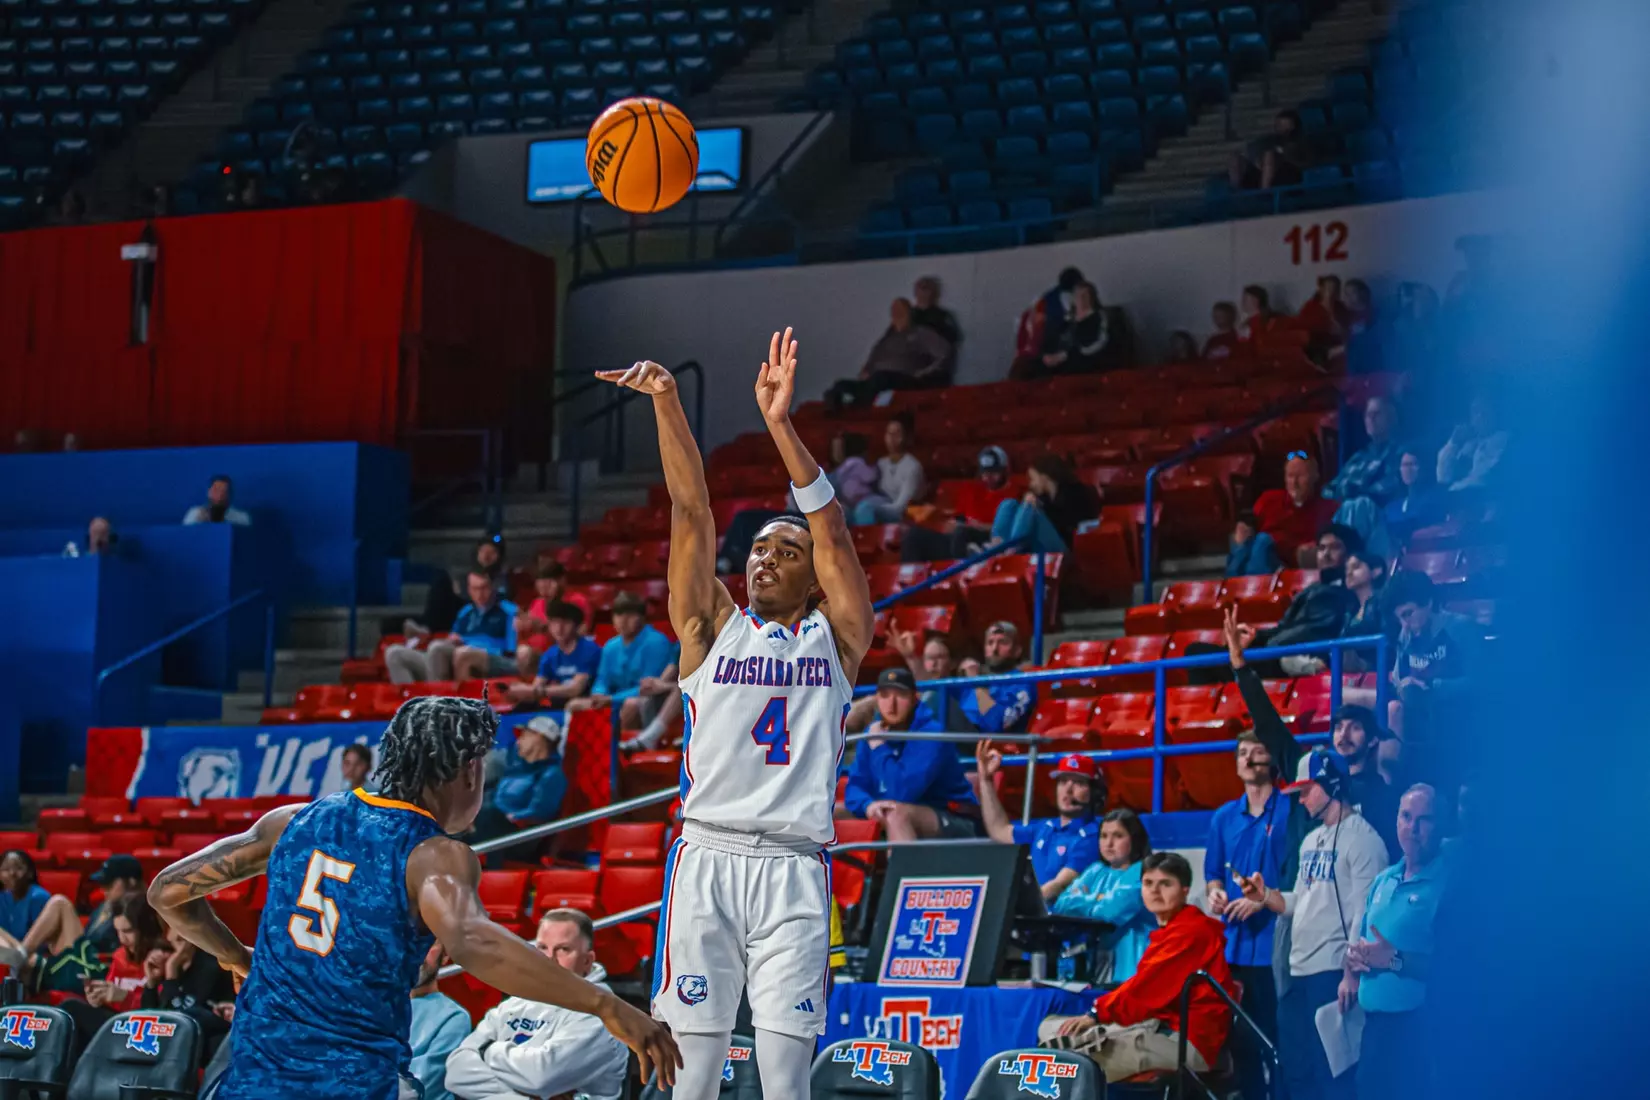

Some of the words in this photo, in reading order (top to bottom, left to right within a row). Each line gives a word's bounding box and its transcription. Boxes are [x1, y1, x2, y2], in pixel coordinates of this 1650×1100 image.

[1283, 221, 1349, 265] 112
[713, 655, 793, 687] LOUISIANA
[797, 657, 832, 687] TECH
[751, 696, 790, 765] 4
[288, 849, 356, 957] 5
[905, 888, 973, 910] BULLDOG
[890, 957, 961, 979] COUNTRY
